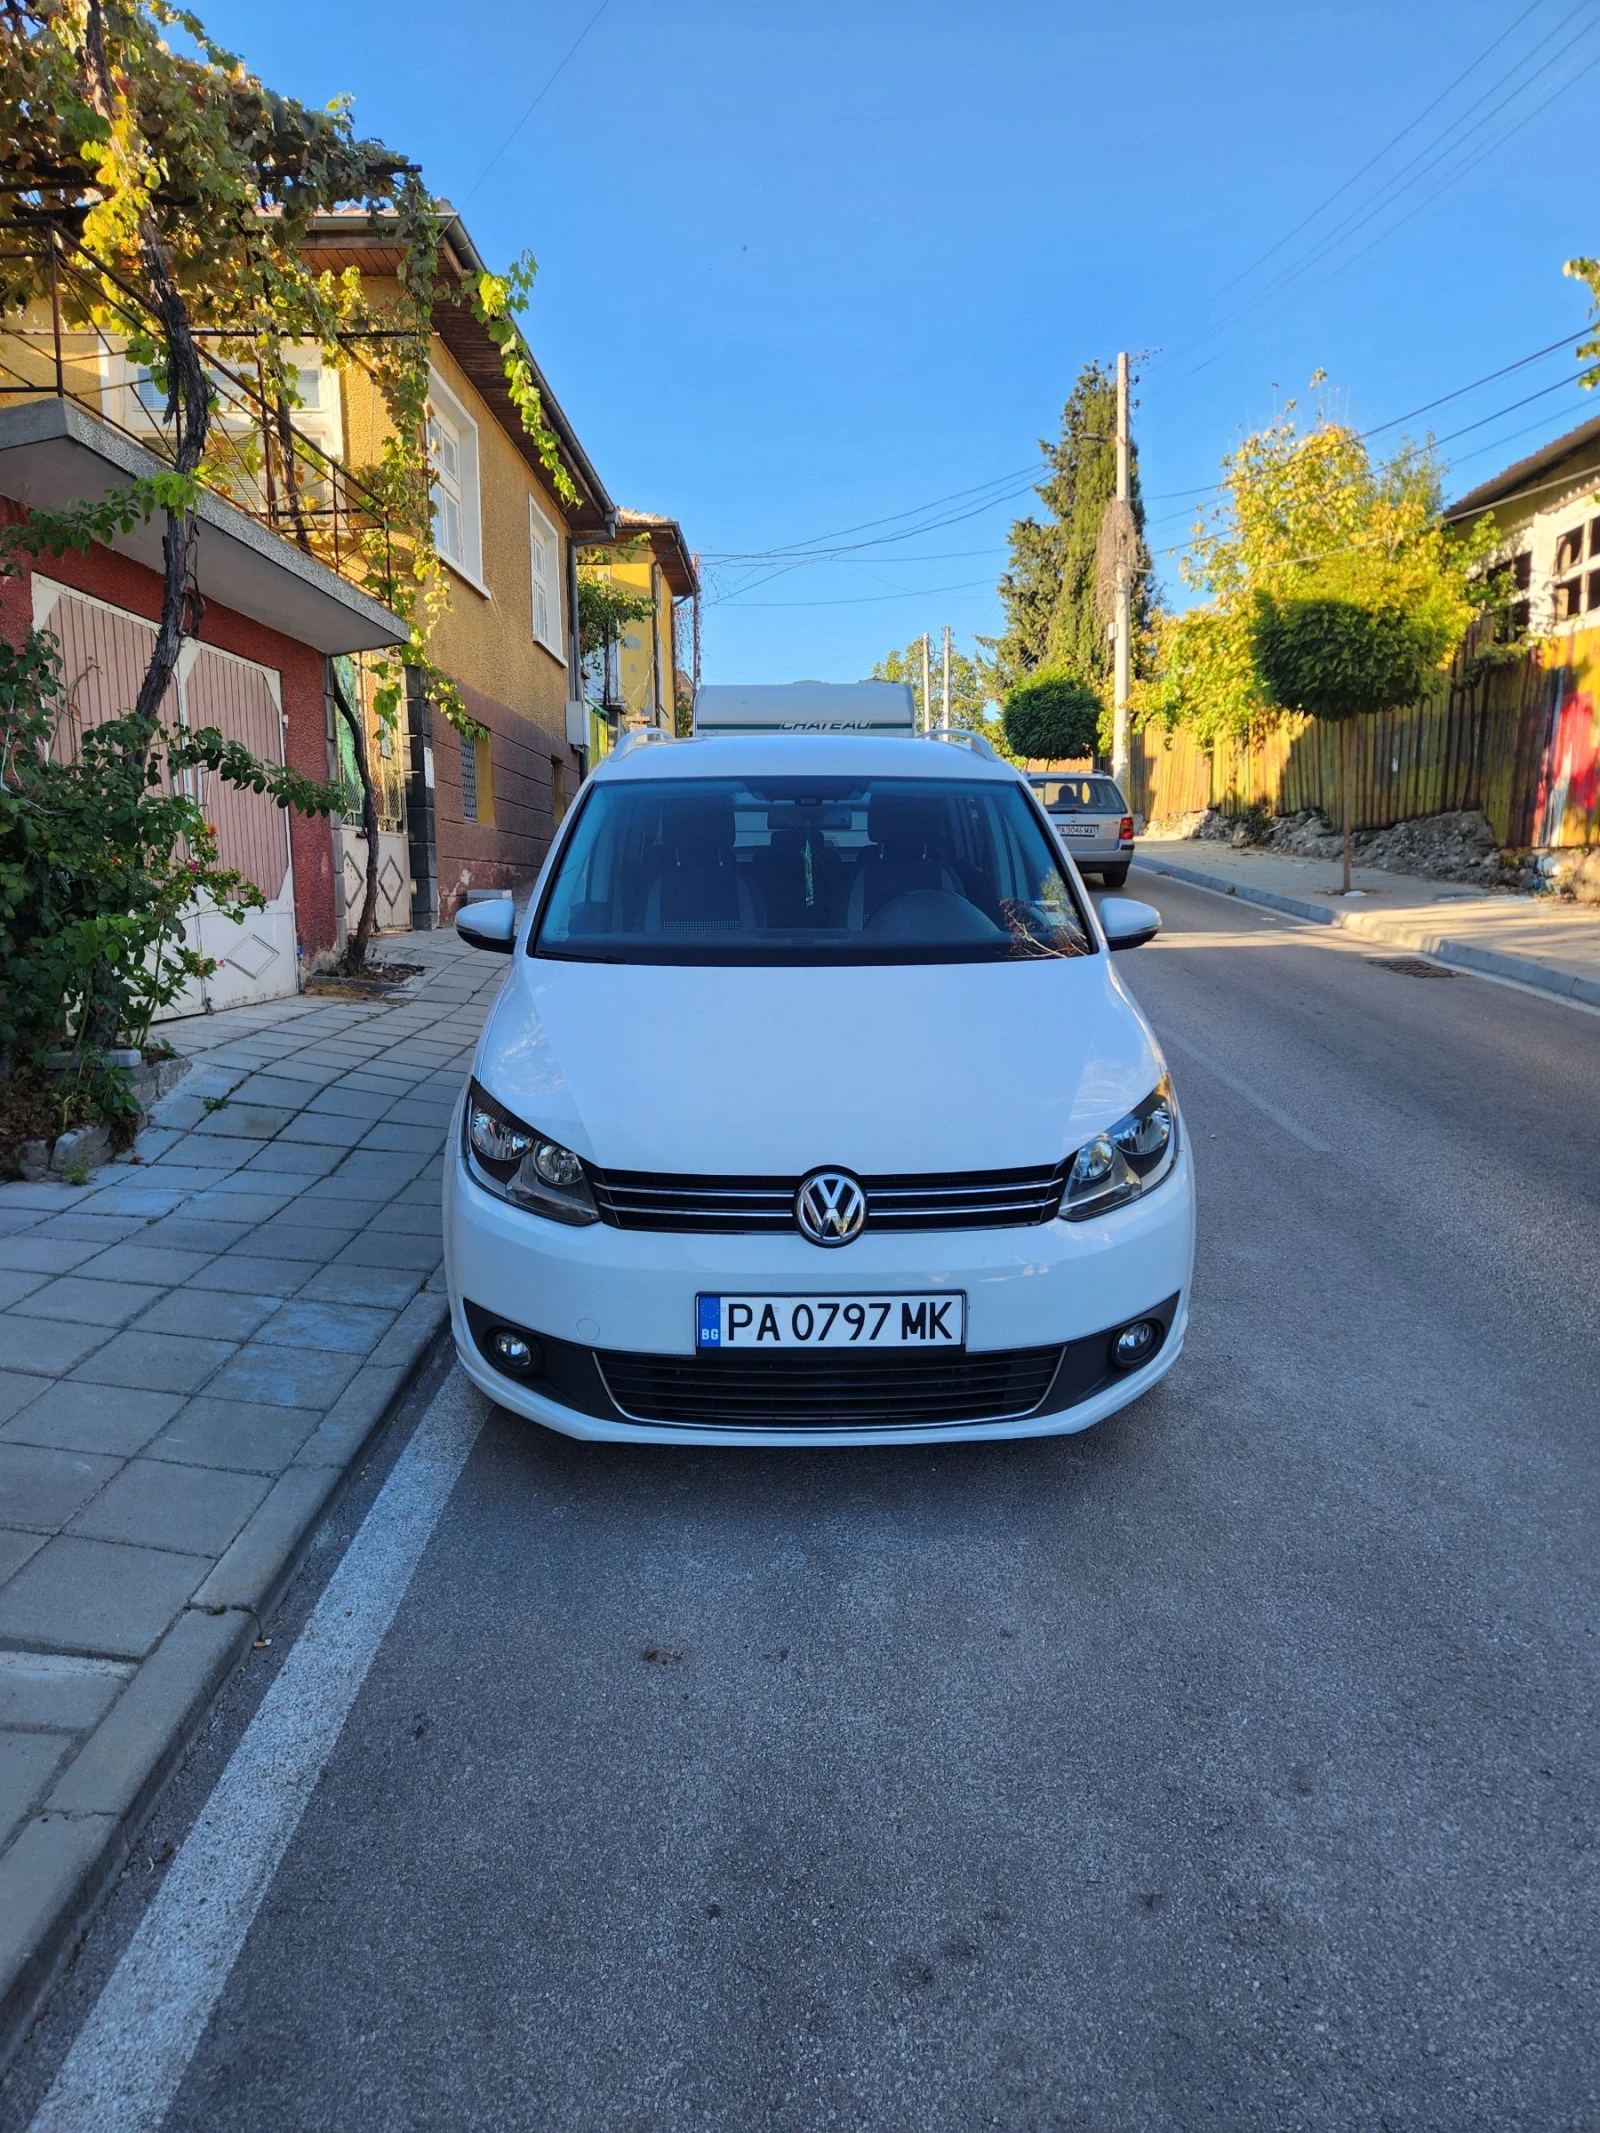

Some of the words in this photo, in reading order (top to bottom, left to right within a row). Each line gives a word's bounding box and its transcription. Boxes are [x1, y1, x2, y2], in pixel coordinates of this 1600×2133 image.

[781, 719, 870, 730] CHATEAU
[728, 1303, 781, 1341] PA
[791, 1302, 892, 1341] 0797
[901, 1301, 953, 1340] MK
[701, 1328, 719, 1340] BG
